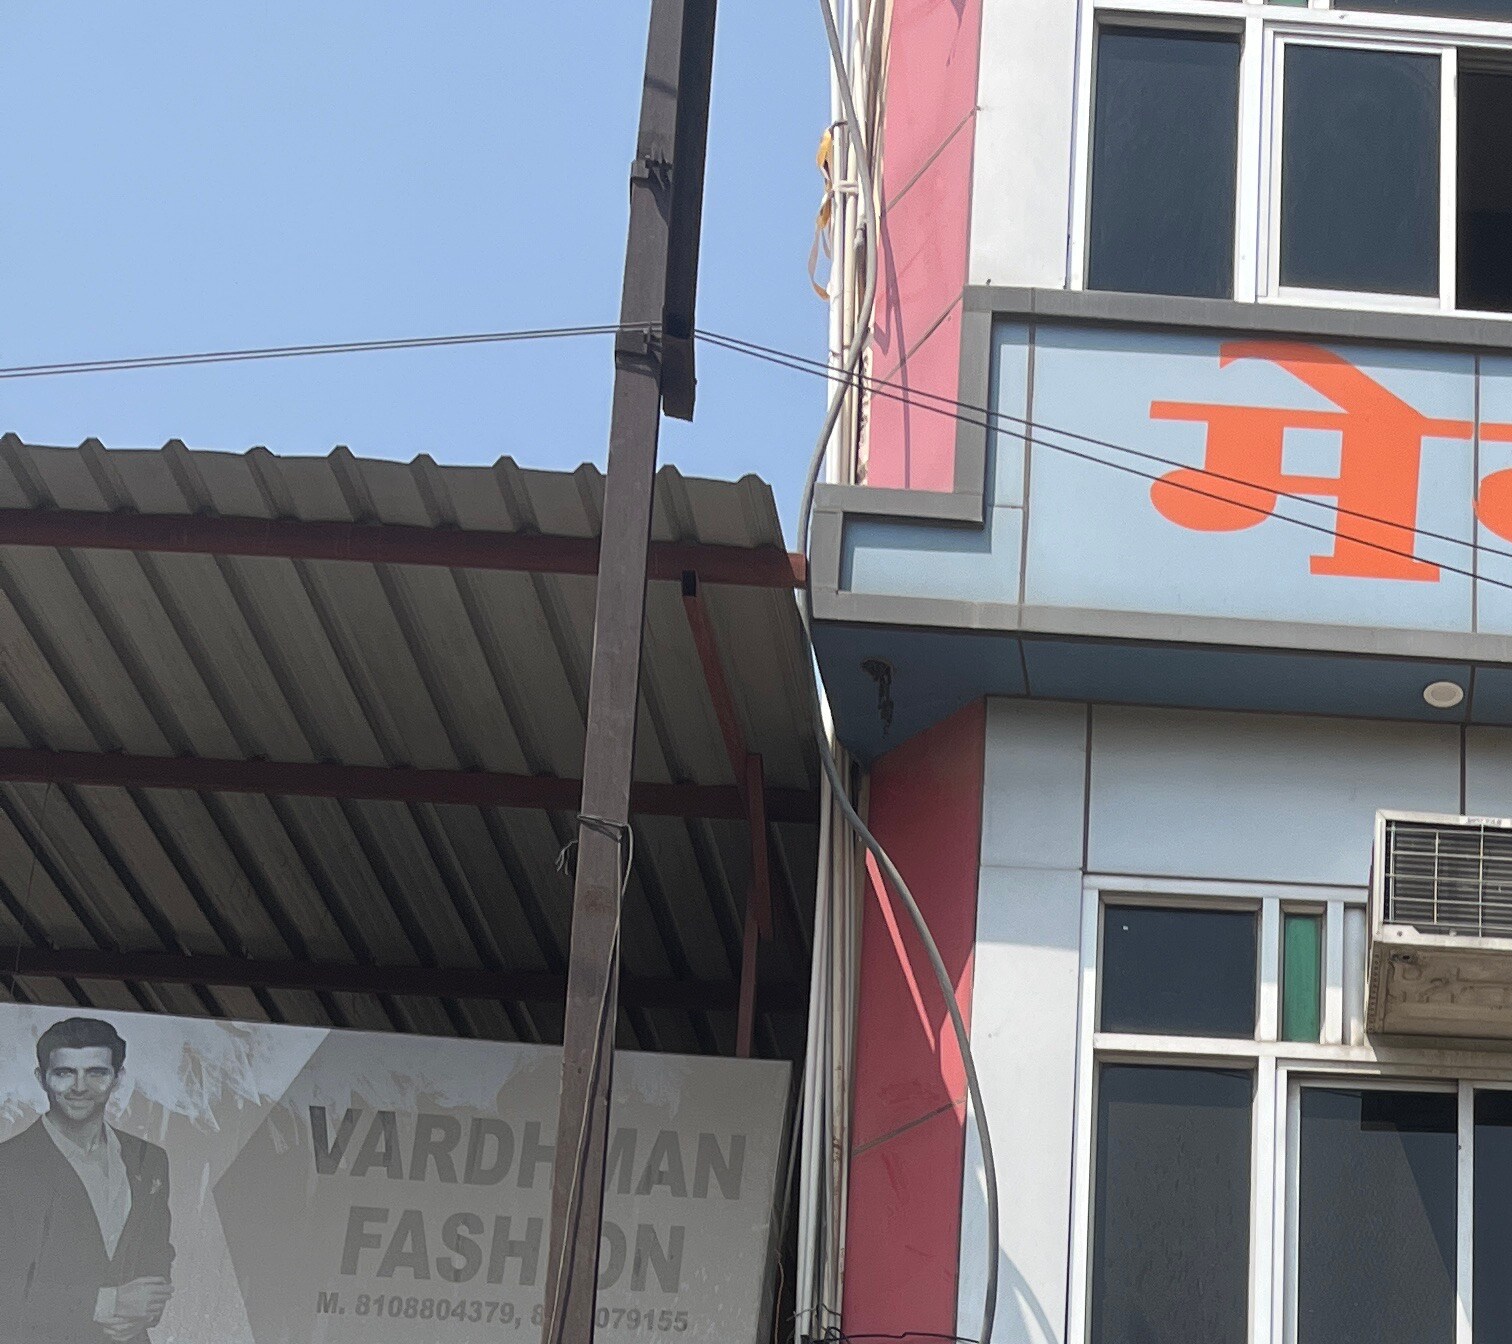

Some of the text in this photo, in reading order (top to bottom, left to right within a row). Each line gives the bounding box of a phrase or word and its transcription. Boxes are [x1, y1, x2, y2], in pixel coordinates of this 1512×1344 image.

[340, 1205, 685, 1294] FASHON
[316, 1291, 346, 1314] M.
[531, 1304, 689, 1332] 8079155
